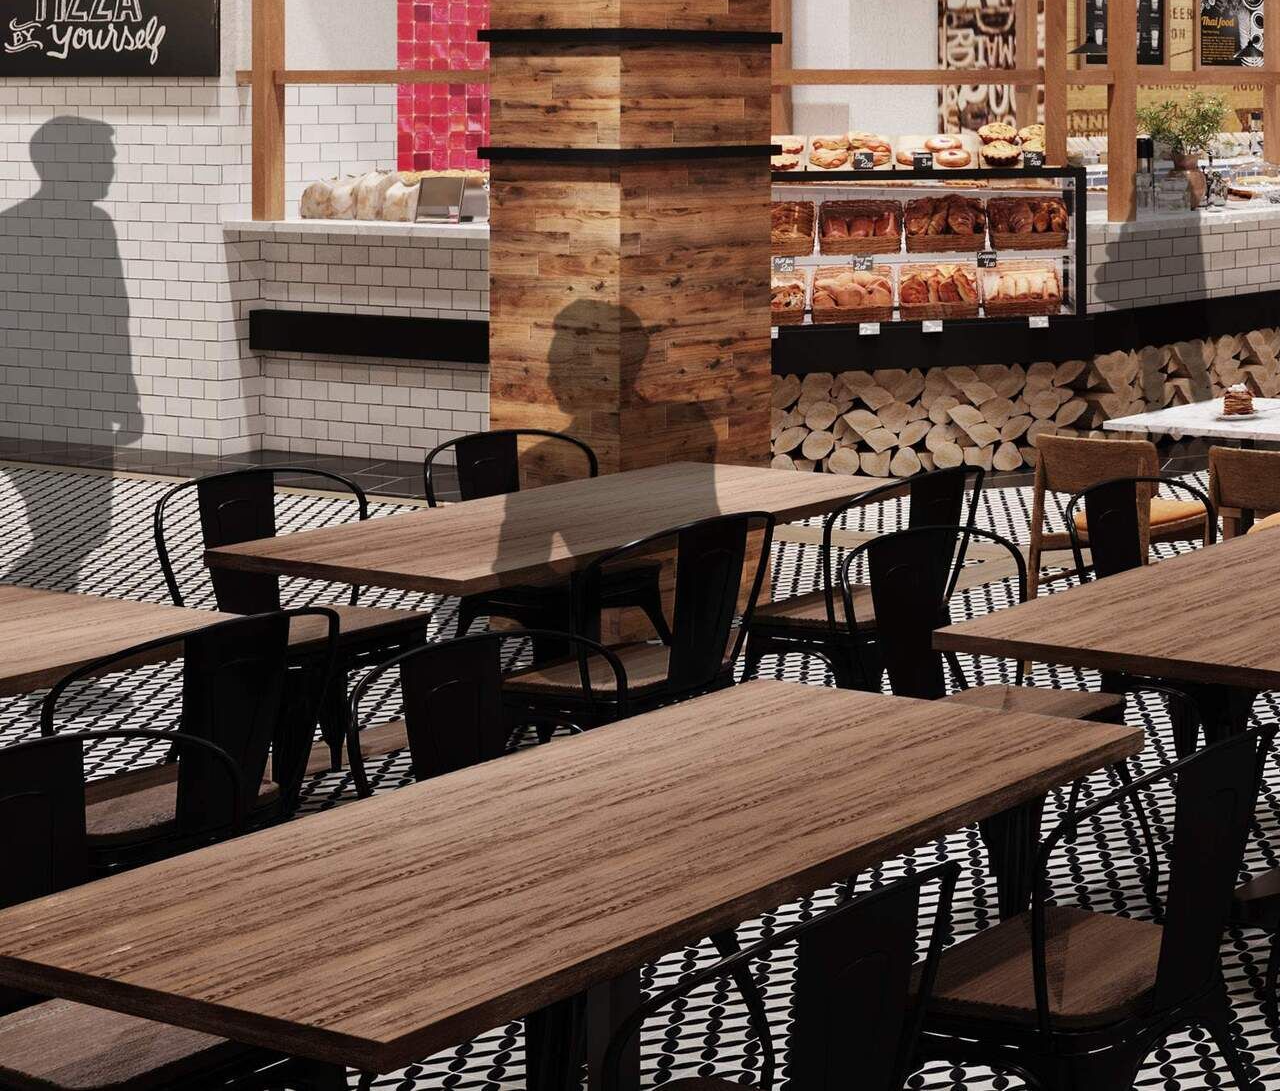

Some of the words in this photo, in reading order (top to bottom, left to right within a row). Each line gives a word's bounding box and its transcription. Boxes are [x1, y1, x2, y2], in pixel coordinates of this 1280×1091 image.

[1170, 7, 1193, 20] EER
[1201, 16, 1218, 26] Thai
[1217, 17, 1235, 29] food
[12, 28, 35, 48] BY
